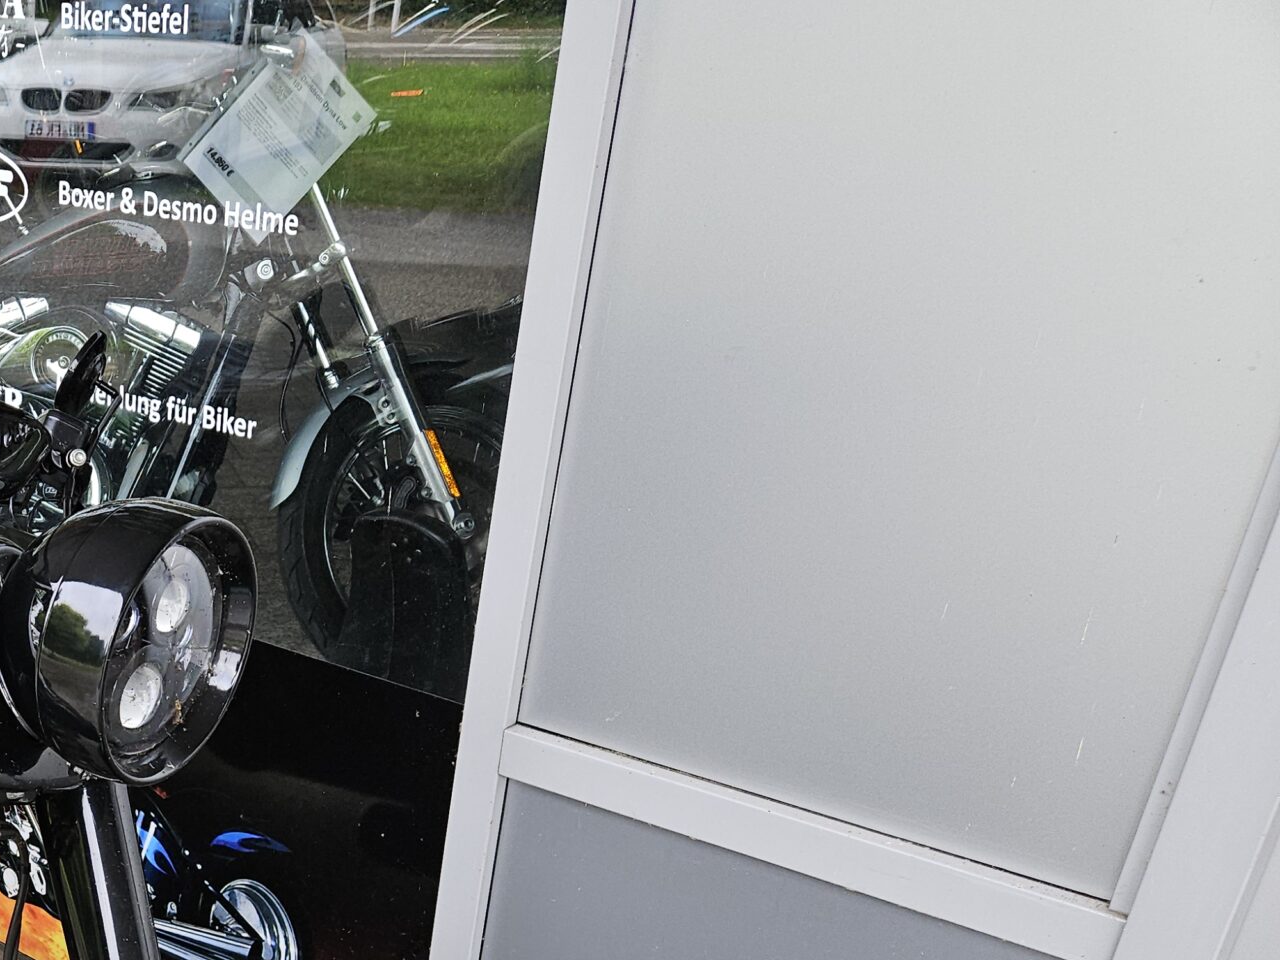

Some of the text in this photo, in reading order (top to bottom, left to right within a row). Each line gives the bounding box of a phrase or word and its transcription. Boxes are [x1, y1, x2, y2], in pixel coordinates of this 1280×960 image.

[61, 2, 189, 35] Biker-Stiefel
[58, 180, 299, 235] Boxer & Desmo Helme
[166, 395, 197, 426] für
[202, 404, 257, 439] Biker
